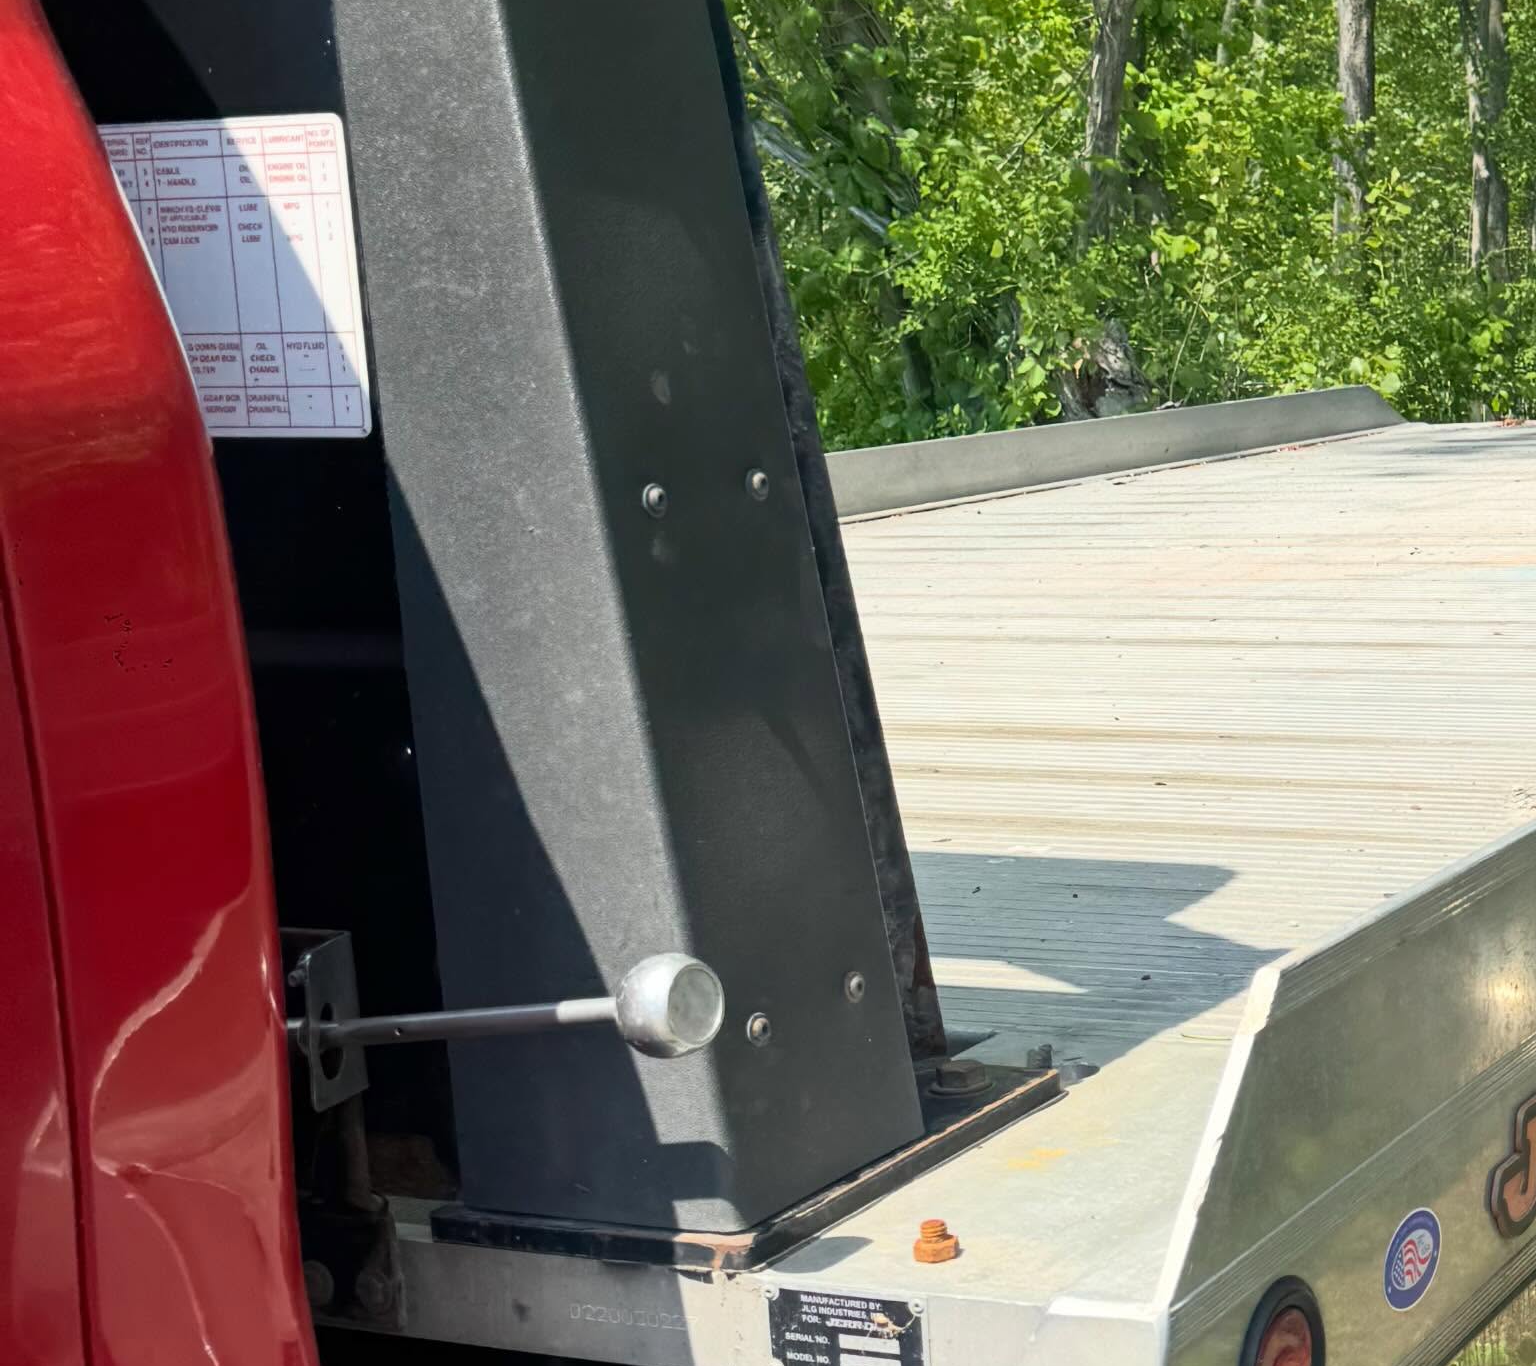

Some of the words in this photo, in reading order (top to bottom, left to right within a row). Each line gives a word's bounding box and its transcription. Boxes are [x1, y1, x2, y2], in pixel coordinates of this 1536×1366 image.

[303, 341, 325, 351] FLUID
[800, 1294, 868, 1310] MANUFACTURED
[802, 1305, 818, 1313] JLG
[802, 1315, 822, 1324] FOR:
[785, 1331, 815, 1343] SERIAL
[816, 1335, 831, 1345] NO.
[786, 1351, 815, 1363] MODEL
[817, 1356, 831, 1365] NO.
